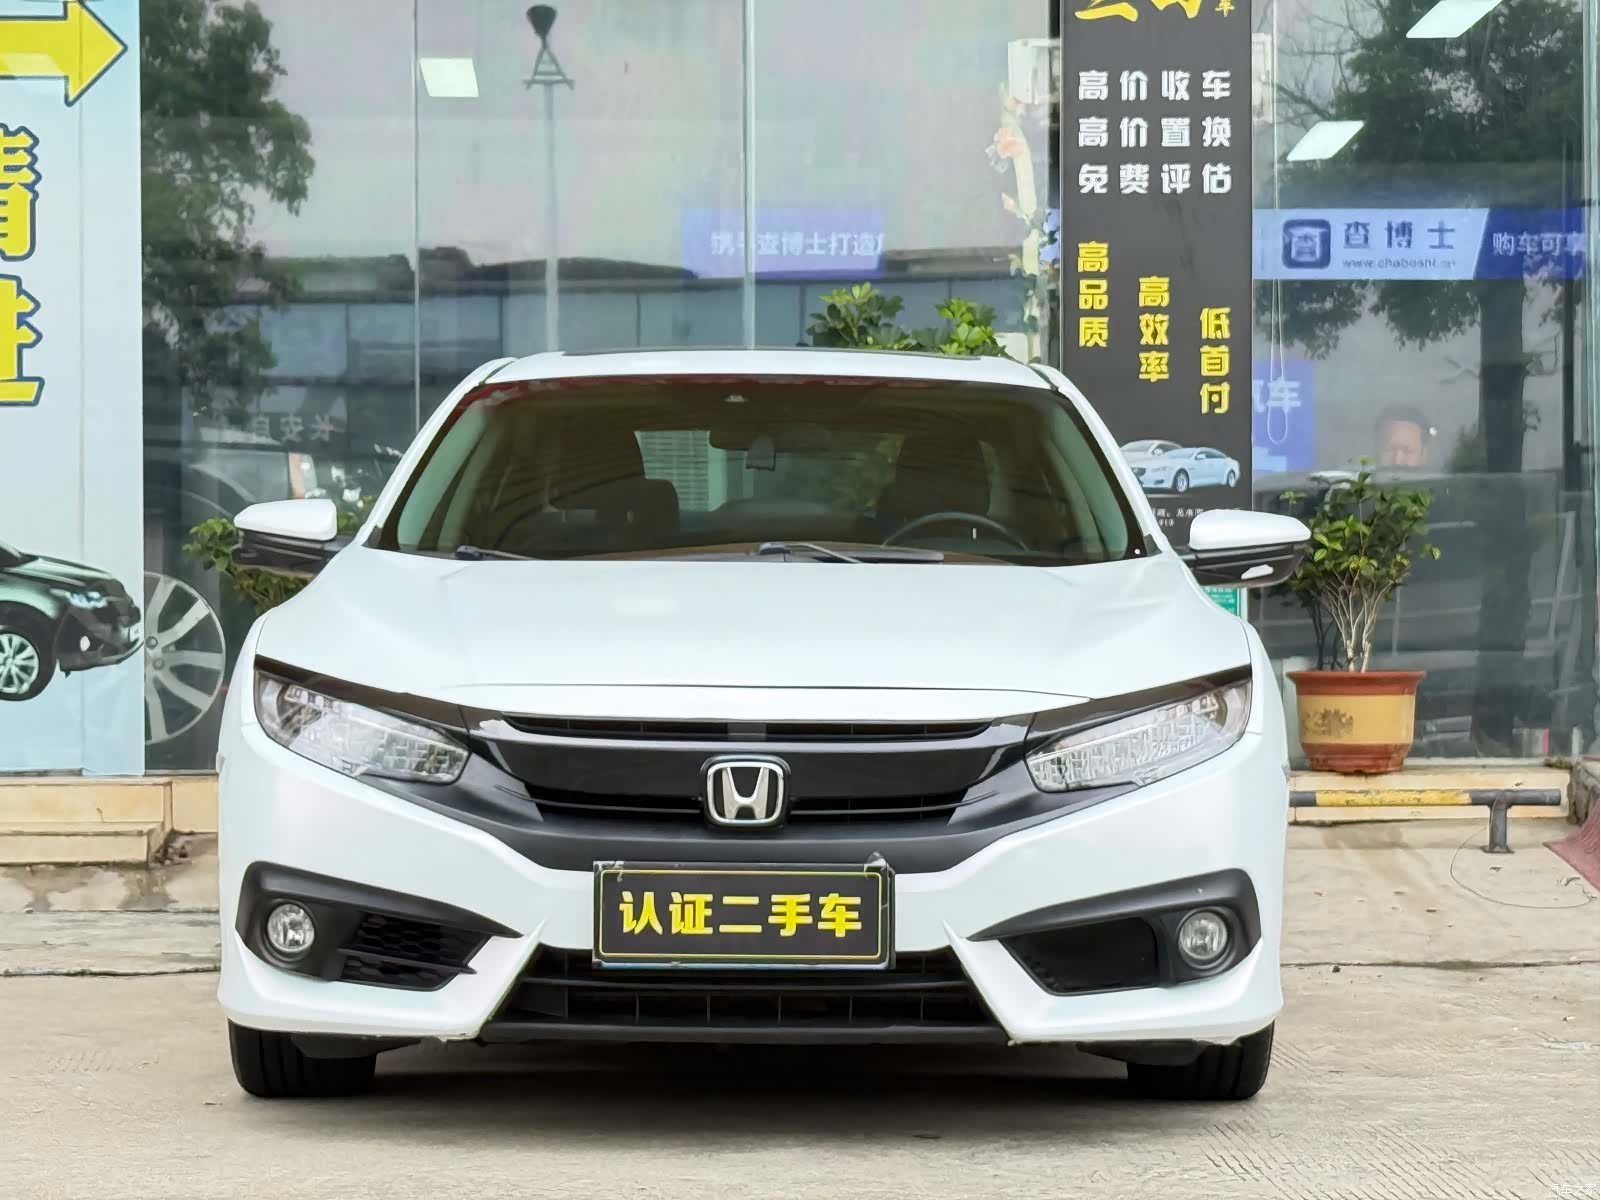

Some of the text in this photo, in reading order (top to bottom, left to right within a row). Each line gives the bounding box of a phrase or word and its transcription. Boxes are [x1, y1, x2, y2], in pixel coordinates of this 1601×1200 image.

[1078, 69, 1232, 101] 高价收车
[1078, 115, 1232, 148] 高价置换
[1078, 162, 1232, 194] 免费评估
[711, 231, 884, 257] 携查博士打造
[1344, 220, 1456, 250] 查博士
[1077, 241, 1109, 348] 高品质
[1138, 275, 1170, 382] 高效率
[1199, 307, 1231, 414] 低首付
[619, 891, 862, 938] 认证二手车
